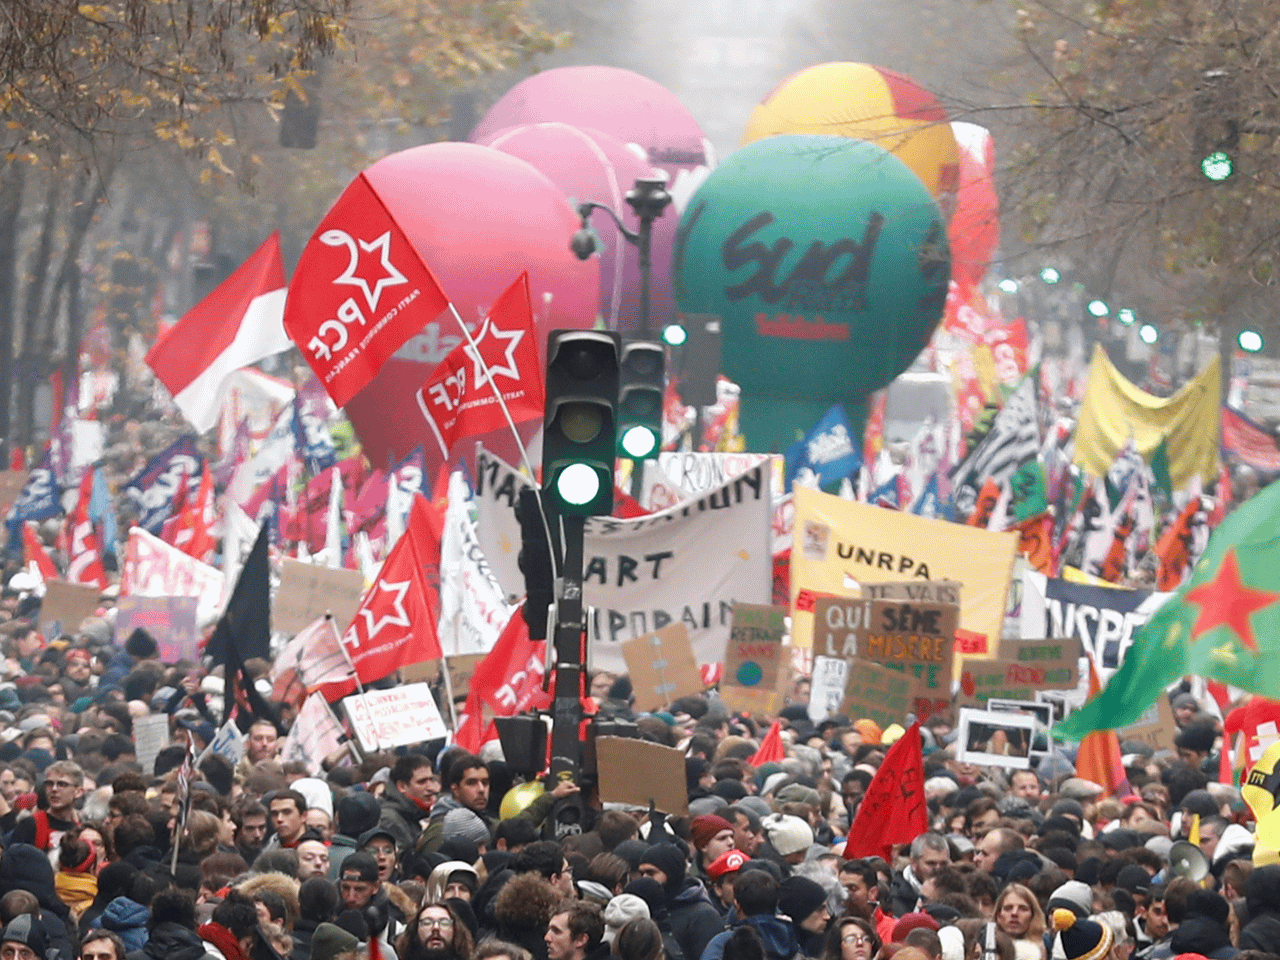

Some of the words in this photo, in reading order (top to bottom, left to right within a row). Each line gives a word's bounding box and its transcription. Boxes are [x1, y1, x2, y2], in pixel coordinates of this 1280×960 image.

[583, 552, 674, 588] ART
[836, 543, 932, 581] UNRPA
[826, 602, 871, 630] QUI
[826, 633, 858, 657] LA
